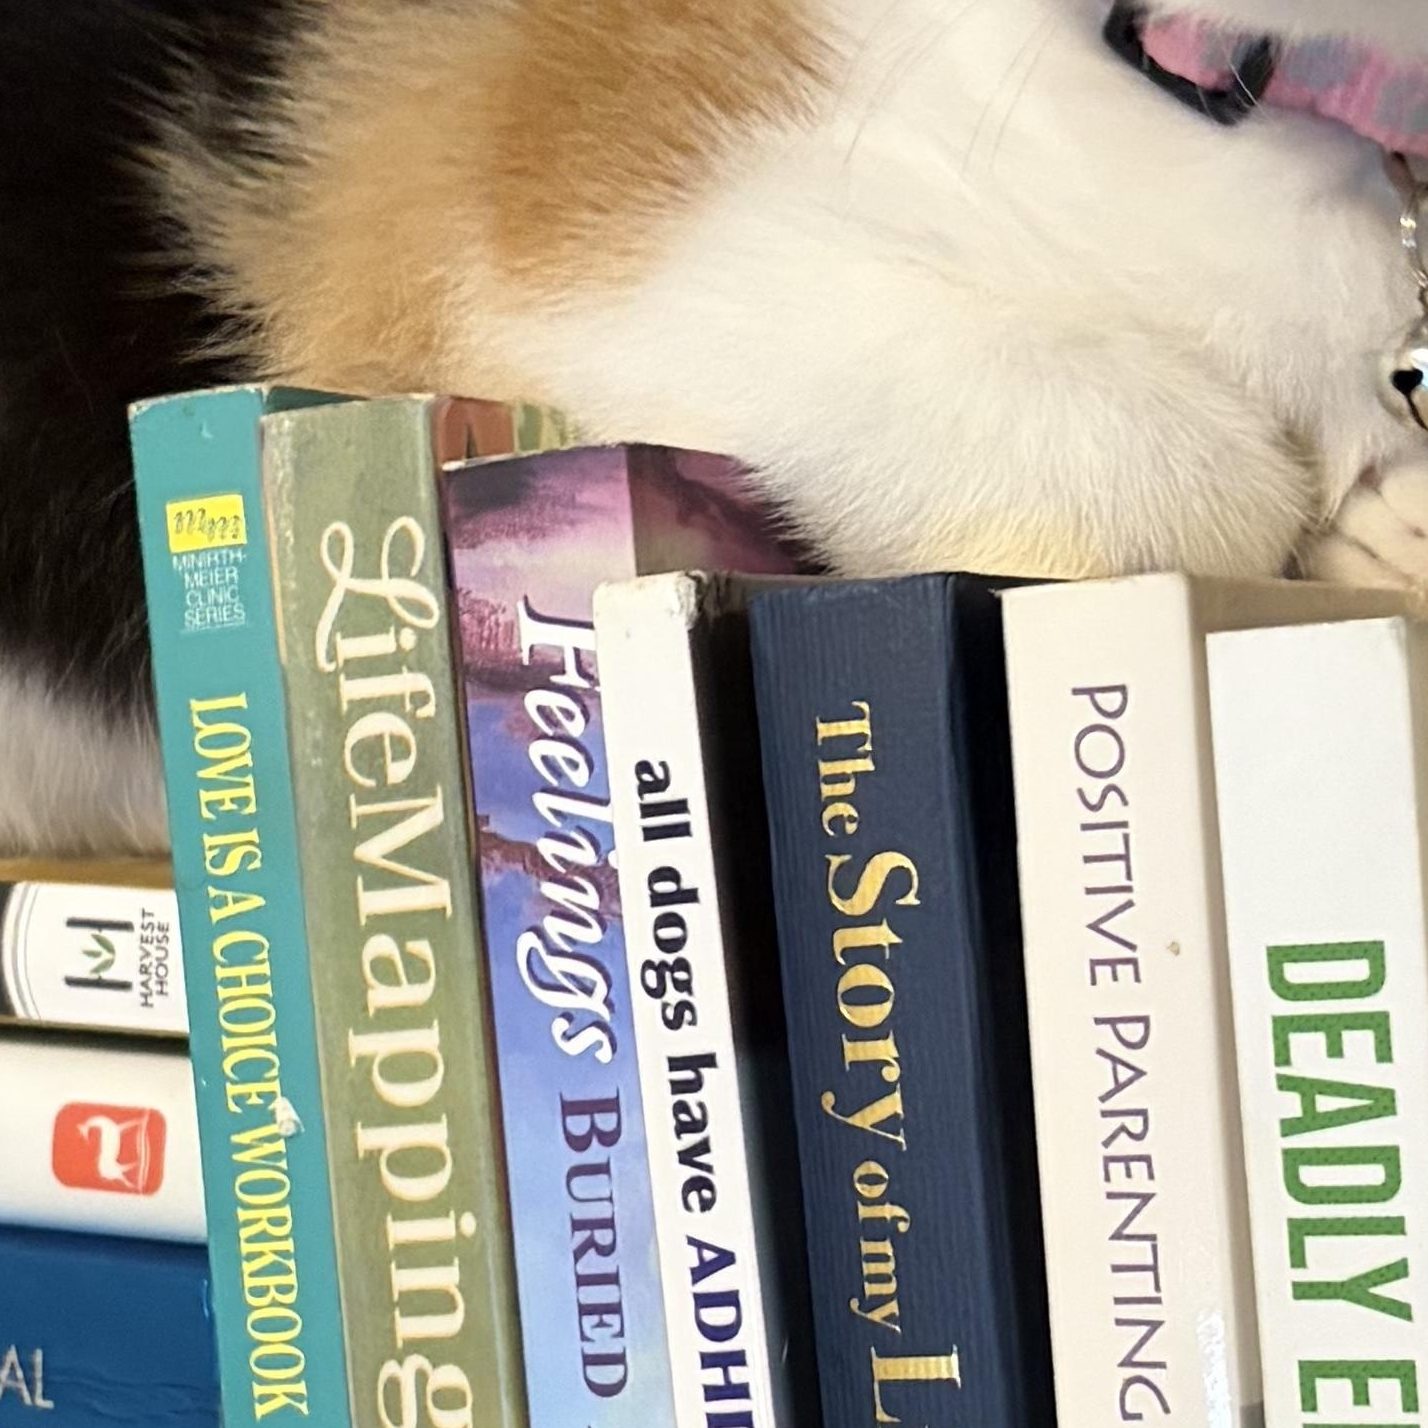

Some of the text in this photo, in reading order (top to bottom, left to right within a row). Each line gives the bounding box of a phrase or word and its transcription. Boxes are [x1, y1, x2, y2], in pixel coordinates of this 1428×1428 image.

[184, 566, 238, 589] MEIER
[184, 603, 246, 624] SERIES
[186, 585, 239, 606] CLINIC
[517, 595, 615, 1065] Feelings
[633, 759, 693, 843] all
[815, 701, 874, 836] The
[1072, 683, 1142, 986] POSITIVE
[139, 908, 154, 1008] HARVEST
[155, 922, 169, 996] HOUSE
[639, 863, 698, 1031] dogs
[821, 851, 920, 1151] Story
[189, 692, 310, 1422] LOVE IS A CHOICE WORKBOOK
[1265, 939, 1413, 1322] DEADLY
[664, 1052, 717, 1214] have
[853, 1160, 910, 1233] of
[558, 1088, 630, 1400] BURIED
[850, 1239, 902, 1334] my
[1094, 1015, 1172, 1422] PARENTING
